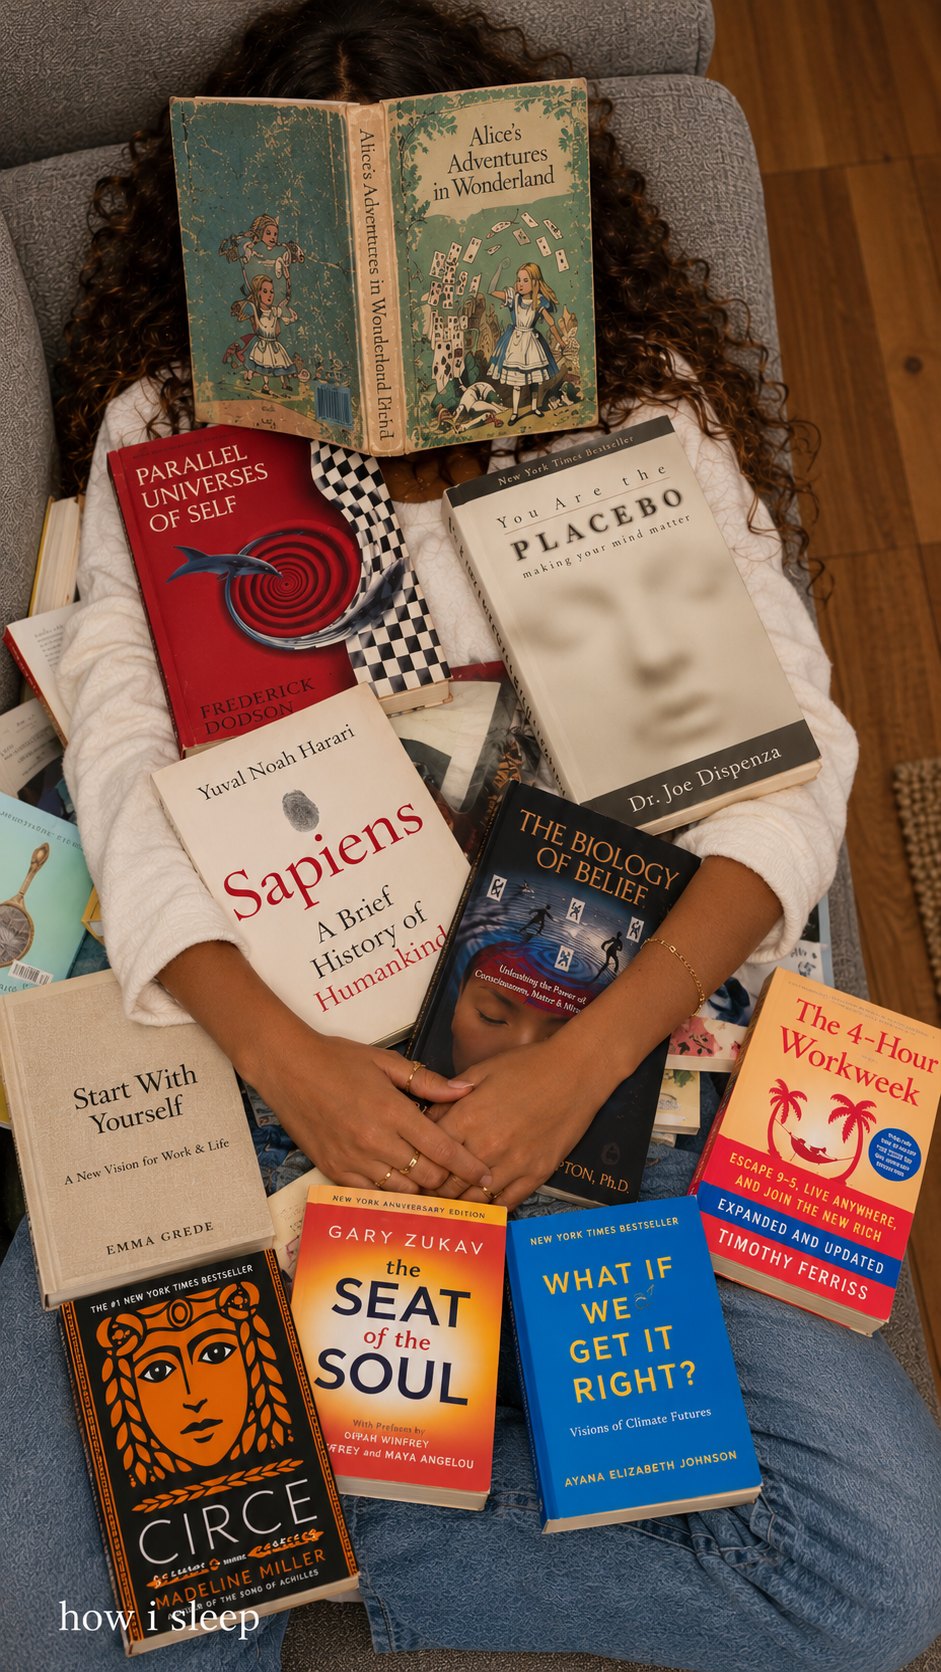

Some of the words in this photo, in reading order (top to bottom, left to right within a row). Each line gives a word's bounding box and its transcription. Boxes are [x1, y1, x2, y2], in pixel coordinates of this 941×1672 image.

[469, 123, 521, 147] Alice's
[447, 147, 548, 174] Adventures
[434, 183, 450, 201] in
[451, 165, 555, 197] Wonderland
[370, 280, 385, 295] in
[135, 444, 248, 486] PARALLEL
[498, 472, 522, 487] New
[524, 463, 550, 479] York
[552, 453, 583, 470] Times
[585, 434, 635, 457] Bestseller
[141, 463, 269, 510] UNIVERSES
[497, 509, 539, 530] You
[554, 485, 603, 511] Are
[622, 463, 667, 487] the
[149, 512, 182, 533] OF
[188, 495, 238, 524] SELF
[510, 488, 684, 562] PLACEBO
[522, 554, 573, 580] making
[576, 543, 608, 562] your
[612, 528, 645, 549] mind
[648, 513, 693, 537] matter
[200, 677, 317, 721] FREDERICK
[204, 702, 295, 737] DODSON
[196, 771, 247, 801] Yuval
[248, 751, 297, 781] Noah
[298, 724, 355, 761] Harari
[628, 793, 660, 814] Dr.
[663, 777, 694, 805] Joe
[696, 745, 782, 788] Dispenza
[223, 802, 424, 921] Sapiens
[519, 809, 565, 846] THE
[570, 830, 680, 890] BIOLOGY
[536, 847, 572, 875] OF
[574, 860, 649, 907] BELIEF
[317, 921, 338, 944] A
[336, 885, 395, 931] Brief
[309, 924, 398, 979] History
[402, 900, 428, 930] of
[313, 923, 449, 1013] Humankind
[556, 1000, 562, 1008] &
[796, 998, 840, 1035] The
[846, 1023, 939, 1075] 4-Hour
[73, 1081, 132, 1111] Start
[135, 1063, 199, 1094] With
[780, 1026, 920, 1107] Workweek
[89, 1094, 185, 1135] Yourself
[64, 1175, 74, 1186] A
[76, 1169, 102, 1183] New
[104, 1160, 140, 1175] Vision
[142, 1154, 159, 1168] for
[161, 1146, 192, 1162] Work
[195, 1144, 205, 1156] &
[208, 1139, 230, 1152] Life
[599, 1173, 630, 1194] Ph.D.
[332, 1194, 352, 1203] NEW
[356, 1198, 380, 1206] YORK
[449, 1208, 486, 1219] EDITION
[729, 1152, 774, 1180] ESCAPE
[803, 1182, 830, 1203] LIVE
[832, 1193, 897, 1231] ANYWHERE,
[734, 1175, 761, 1195] AND
[762, 1186, 793, 1208] JOIN
[795, 1199, 818, 1219] THE
[822, 1208, 850, 1230] NEW
[852, 1220, 883, 1243] RICH
[106, 1235, 155, 1256] EMMA
[161, 1221, 215, 1242] GREDE
[328, 1225, 393, 1245] GARY
[404, 1232, 484, 1256] ZUKAV
[530, 1235, 553, 1246] NEW
[556, 1230, 583, 1243] YORK
[586, 1225, 617, 1238] TIMES
[619, 1216, 679, 1233] BESTSELLER
[717, 1197, 788, 1236] EXPANDED
[792, 1225, 820, 1248] AND
[824, 1238, 885, 1276] UPDATED
[386, 1258, 421, 1279] the
[543, 1261, 633, 1296] WHAT
[645, 1256, 672, 1281] IF
[719, 1228, 794, 1270] TIMOTHY
[797, 1261, 869, 1301] FERRISS
[90, 1302, 109, 1314] THE
[110, 1298, 122, 1310] #1
[124, 1292, 145, 1305] NEW
[146, 1286, 171, 1300] YORK
[172, 1278, 200, 1293] TIMES
[201, 1264, 254, 1285] BESTSELLER
[331, 1277, 472, 1329] SEAT
[581, 1297, 632, 1325] WE
[363, 1326, 390, 1350] of
[395, 1329, 431, 1351] the
[569, 1332, 630, 1364] GET
[644, 1325, 673, 1353] IT
[314, 1347, 469, 1407] SOUL
[573, 1360, 697, 1404] RIGHT?
[352, 1419, 373, 1429] With
[376, 1423, 412, 1434] Prefaces
[415, 1426, 426, 1437] by
[381, 1436, 430, 1449] WINFREY
[569, 1424, 610, 1439] Visions
[612, 1419, 624, 1431] of
[625, 1412, 668, 1428] Climate
[670, 1406, 712, 1422] Futures
[363, 1447, 381, 1458] and
[385, 1450, 417, 1463] MAYA
[420, 1455, 475, 1469] ANGELOU
[564, 1472, 606, 1488] AYANA
[609, 1460, 675, 1481] ELIZABETH
[680, 1450, 737, 1470] JOHNSON
[138, 1478, 319, 1565] CIRCE
[154, 1569, 252, 1611] MADELINE
[259, 1549, 327, 1580] MILLER
[206, 1598, 218, 1608] OF
[220, 1593, 237, 1604] THE
[265, 1581, 278, 1591] OF
[279, 1568, 320, 1587] ACHILLES
